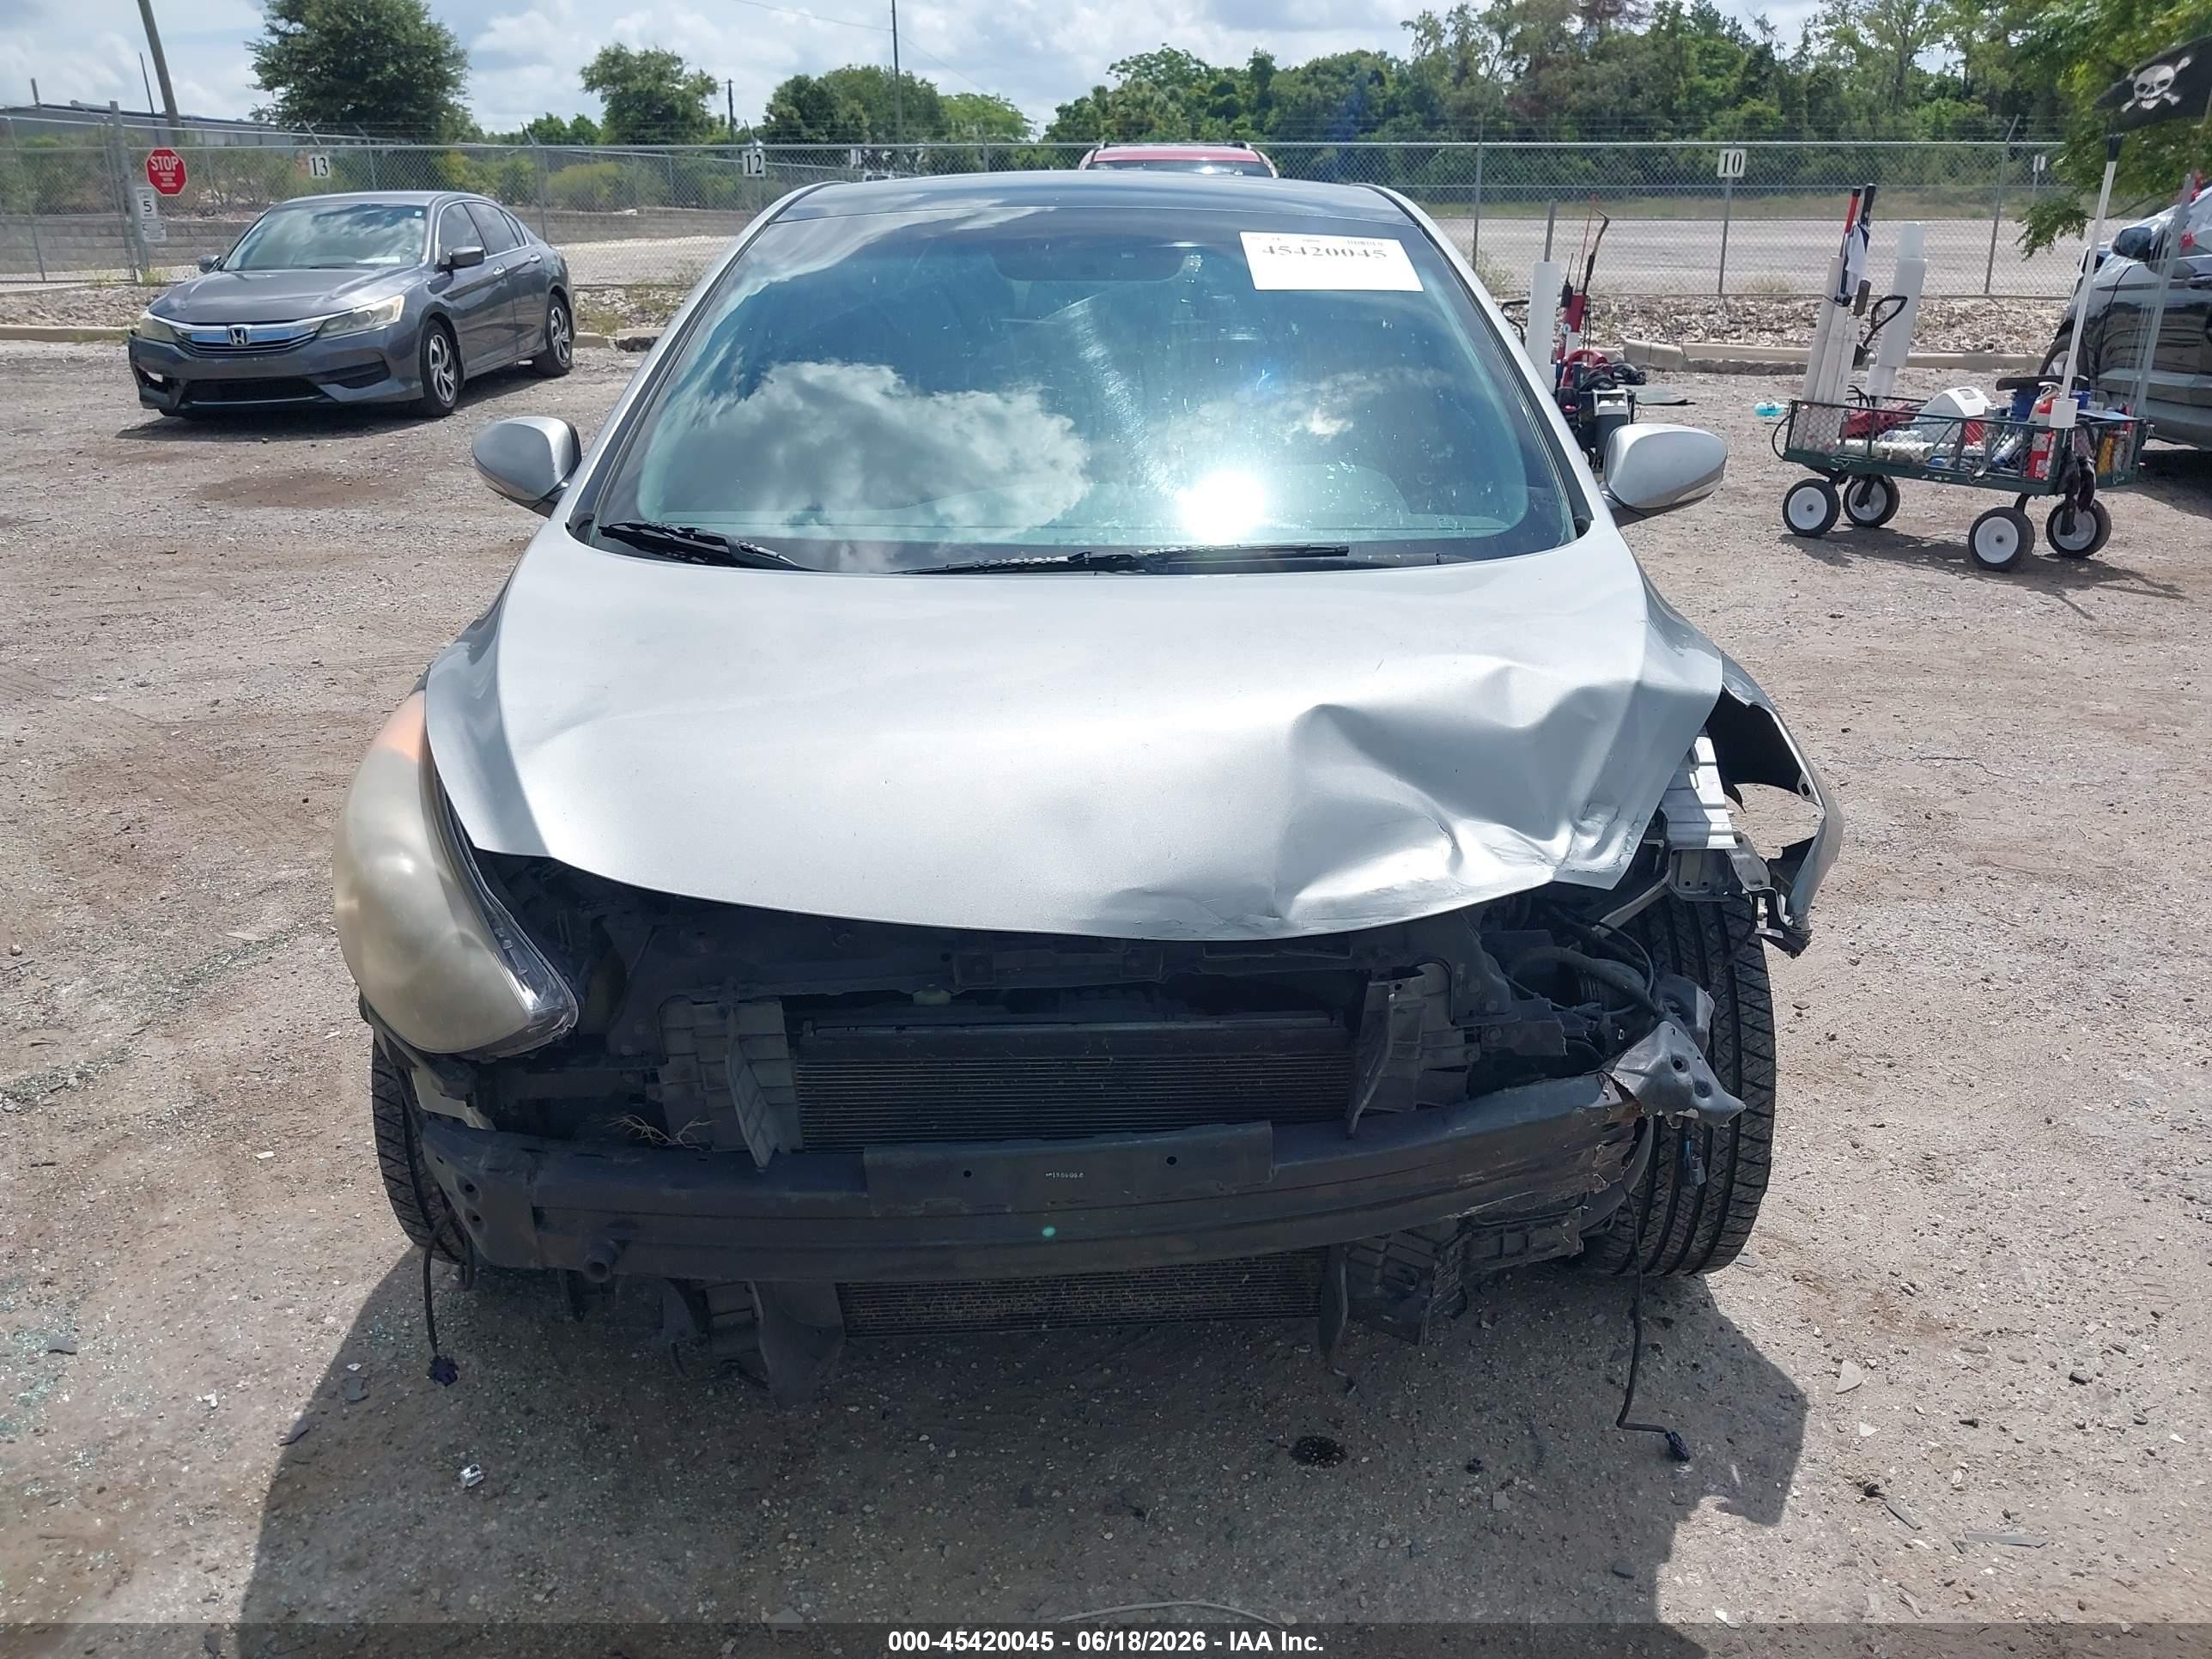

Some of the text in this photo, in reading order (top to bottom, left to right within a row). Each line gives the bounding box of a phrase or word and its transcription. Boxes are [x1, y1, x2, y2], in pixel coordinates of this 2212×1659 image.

[149, 155, 179, 172] STOP
[311, 157, 328, 176] 13
[746, 155, 763, 173] 12
[1723, 151, 1742, 174] 10
[143, 200, 152, 212] 5
[1261, 245, 1388, 260] 45420045
